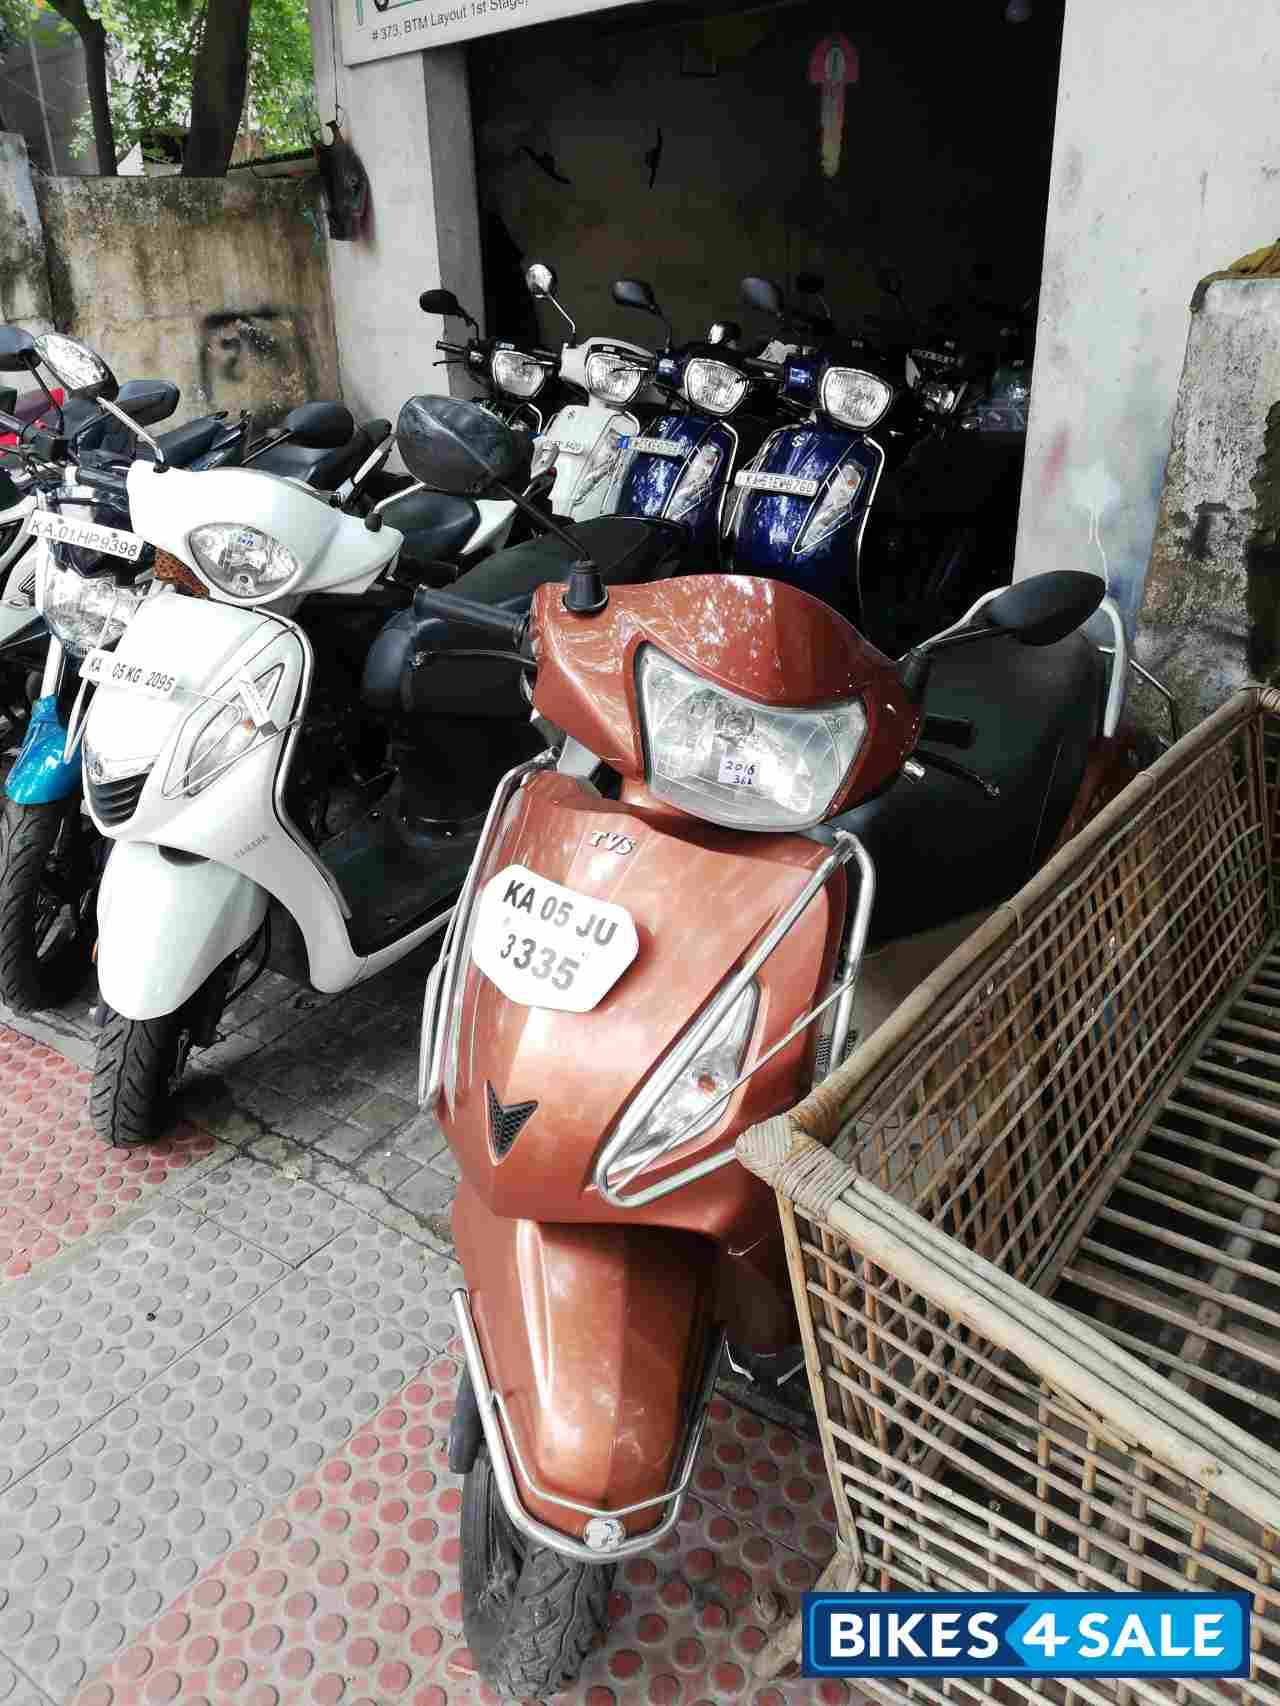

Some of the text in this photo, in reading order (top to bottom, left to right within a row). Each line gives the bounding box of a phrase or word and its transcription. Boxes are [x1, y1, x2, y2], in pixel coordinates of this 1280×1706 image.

[404, 16, 428, 34] BTM
[430, 6, 469, 27] Layout
[471, 4, 488, 18] 1st
[89, 656, 176, 692] KA 05 KG 2095
[725, 759, 755, 776] 2016
[590, 830, 637, 856] TVS
[502, 879, 619, 947] KA 05 JU
[500, 933, 581, 991] 3335
